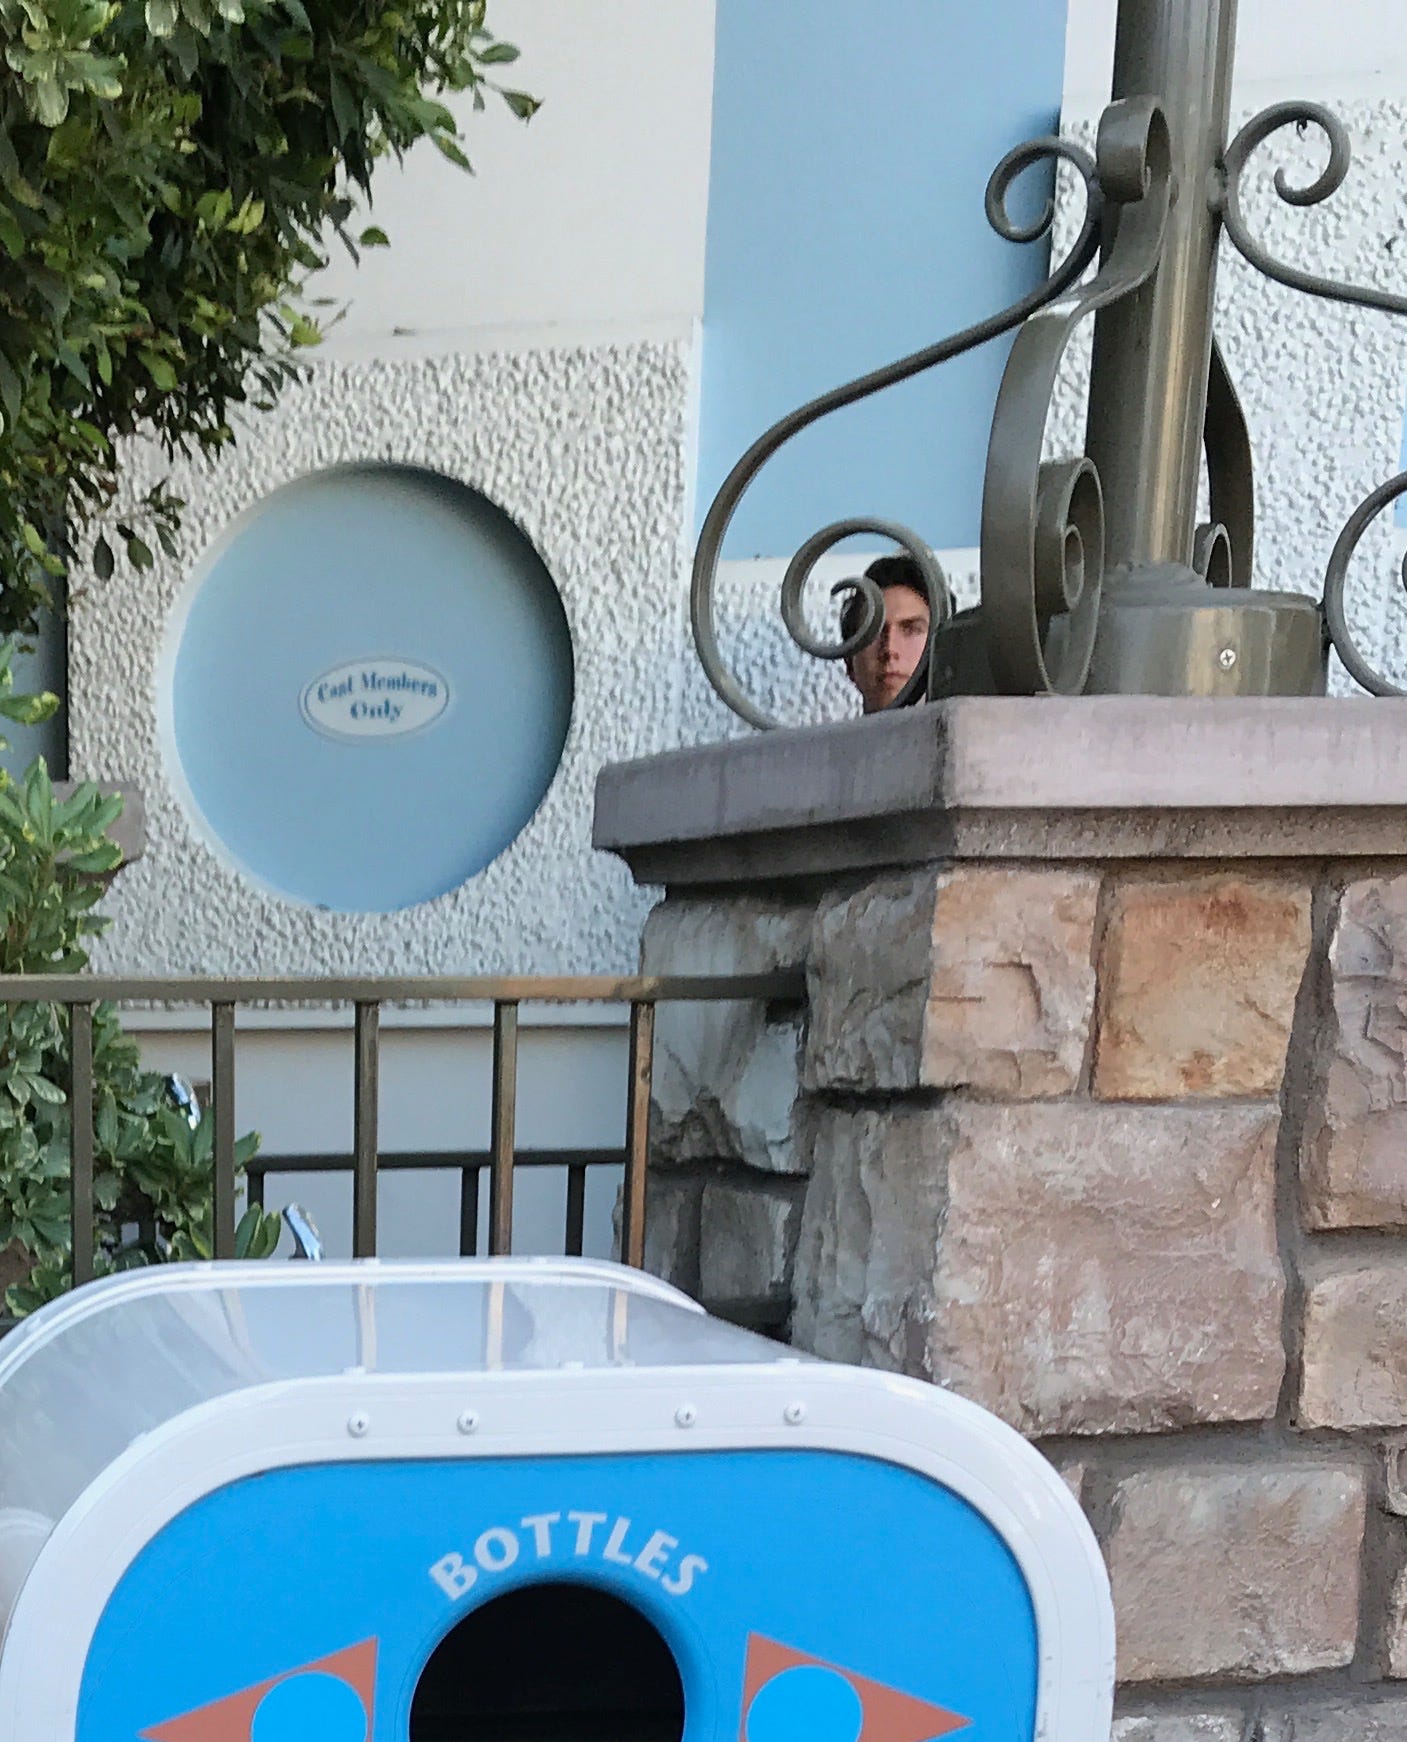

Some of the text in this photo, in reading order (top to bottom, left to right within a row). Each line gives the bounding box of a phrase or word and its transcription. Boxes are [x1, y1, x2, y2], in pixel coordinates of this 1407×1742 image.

[361, 671, 438, 698] Members
[350, 697, 404, 723] Only
[428, 1510, 709, 1601] BOTTLES
